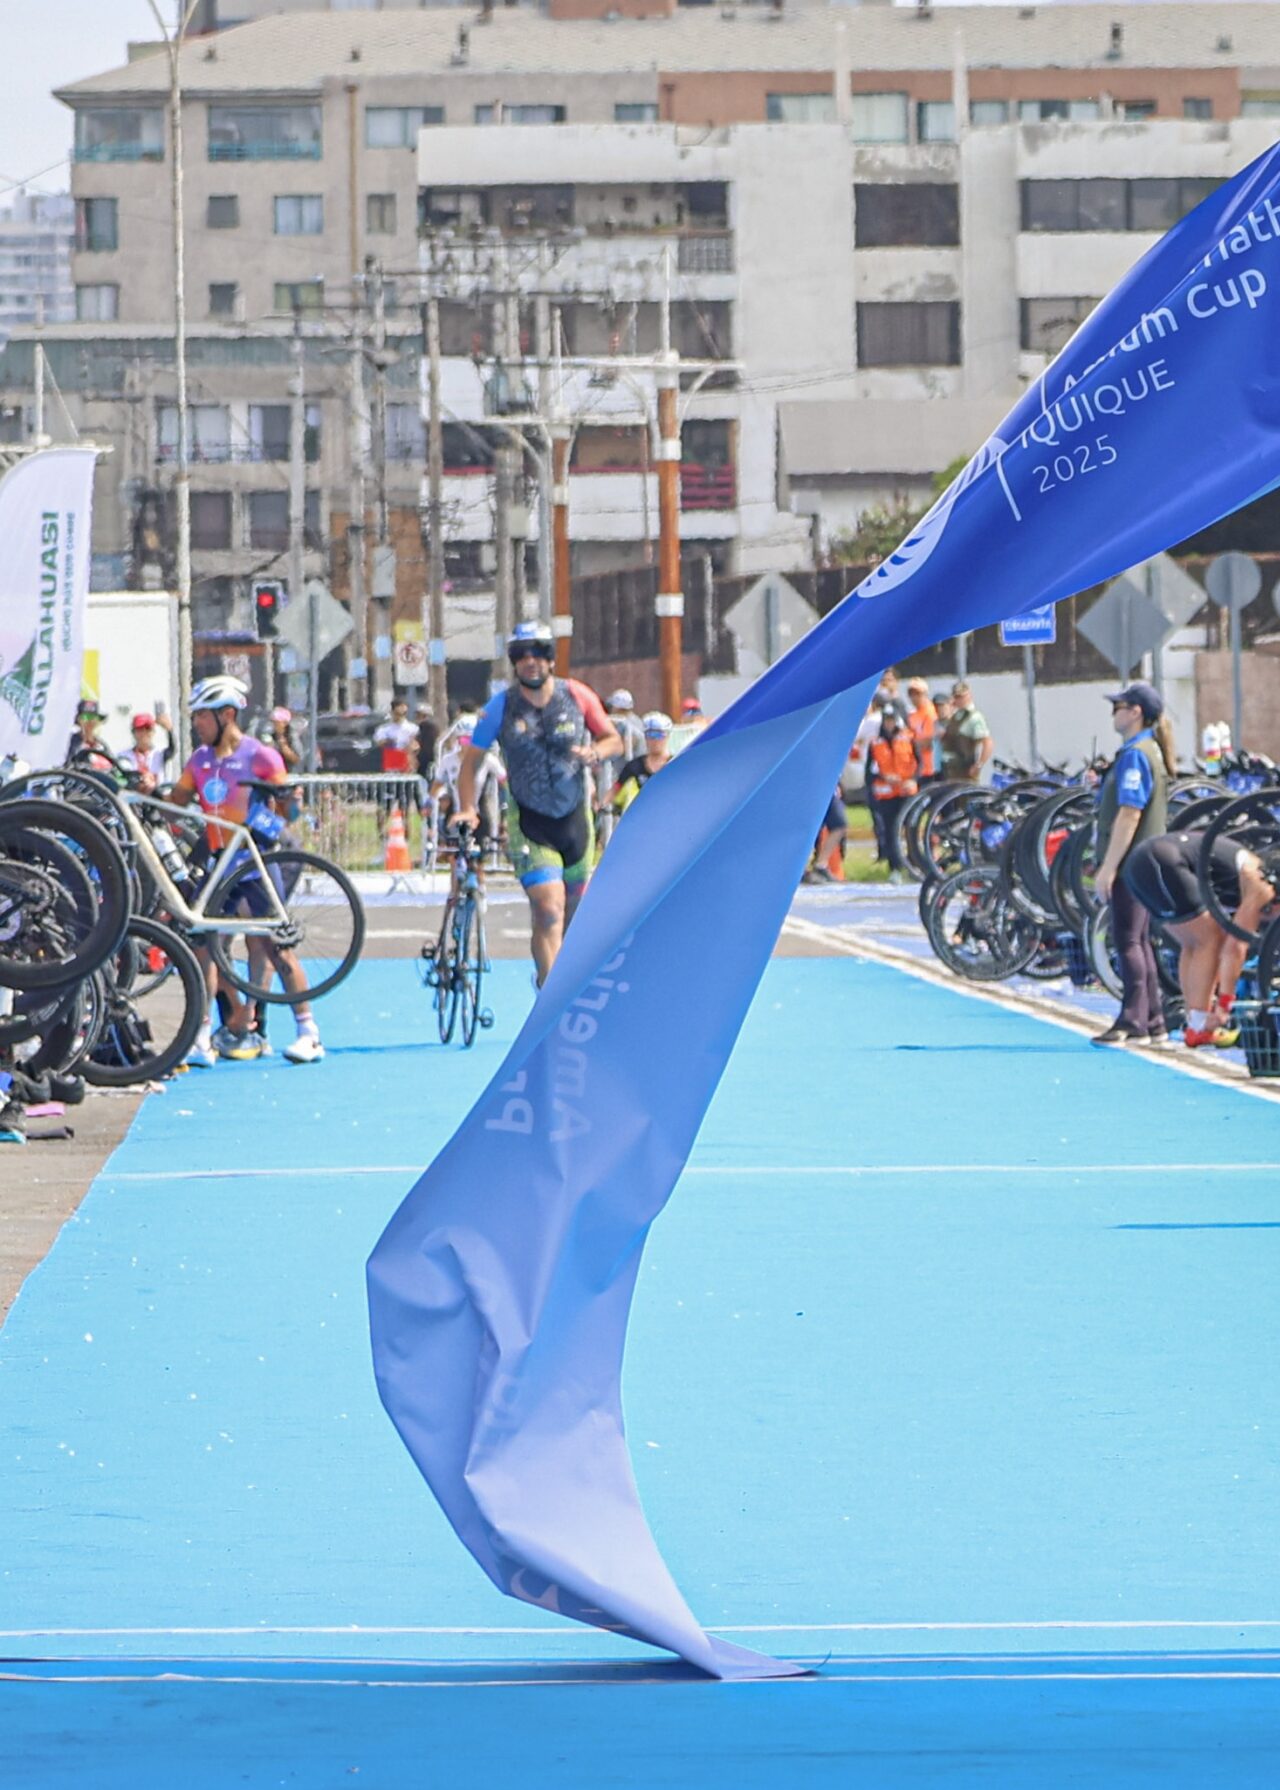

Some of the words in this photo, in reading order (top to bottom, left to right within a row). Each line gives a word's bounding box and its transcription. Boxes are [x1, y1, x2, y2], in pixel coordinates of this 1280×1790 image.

[1187, 268, 1267, 319] Cup
[1032, 434, 1118, 493] 2025
[27, 511, 60, 736] COLLAHUASI
